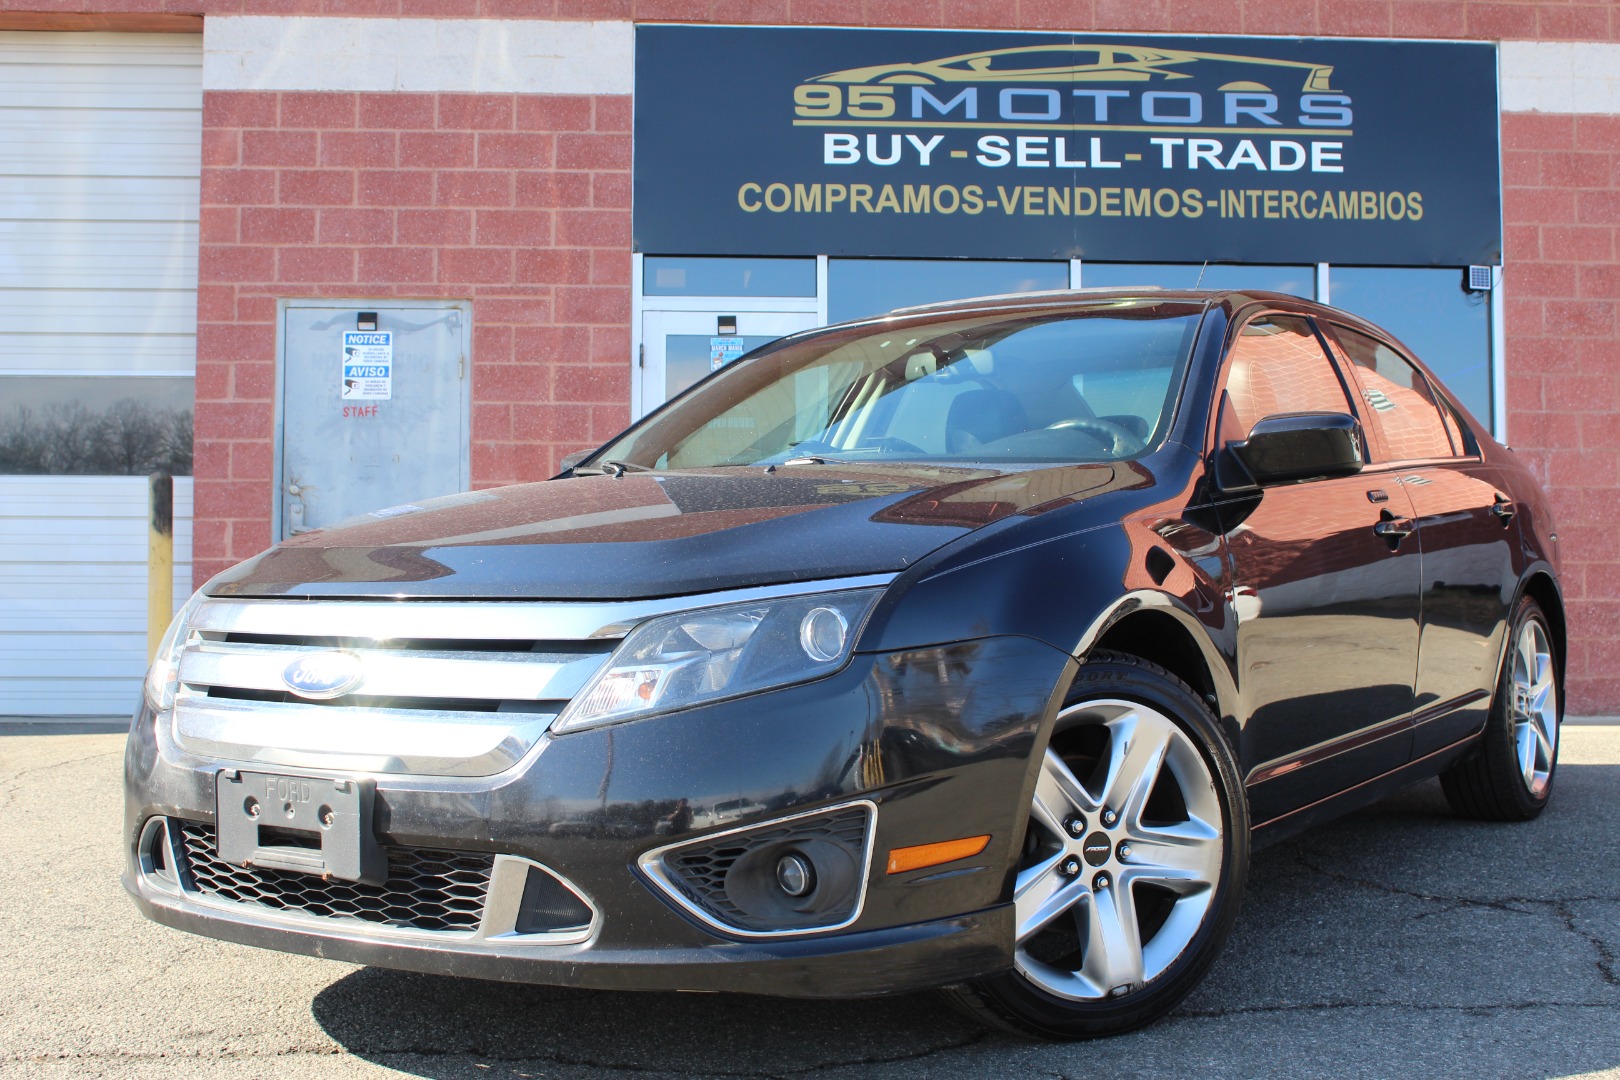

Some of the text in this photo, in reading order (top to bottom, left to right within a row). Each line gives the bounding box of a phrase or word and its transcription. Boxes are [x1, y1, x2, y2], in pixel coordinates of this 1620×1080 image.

[348, 334, 387, 345] NOTICE
[349, 367, 386, 377] AVISO
[343, 405, 379, 417] STAFF
[728, 416, 755, 429] HOURS
[265, 777, 312, 803] FORD
